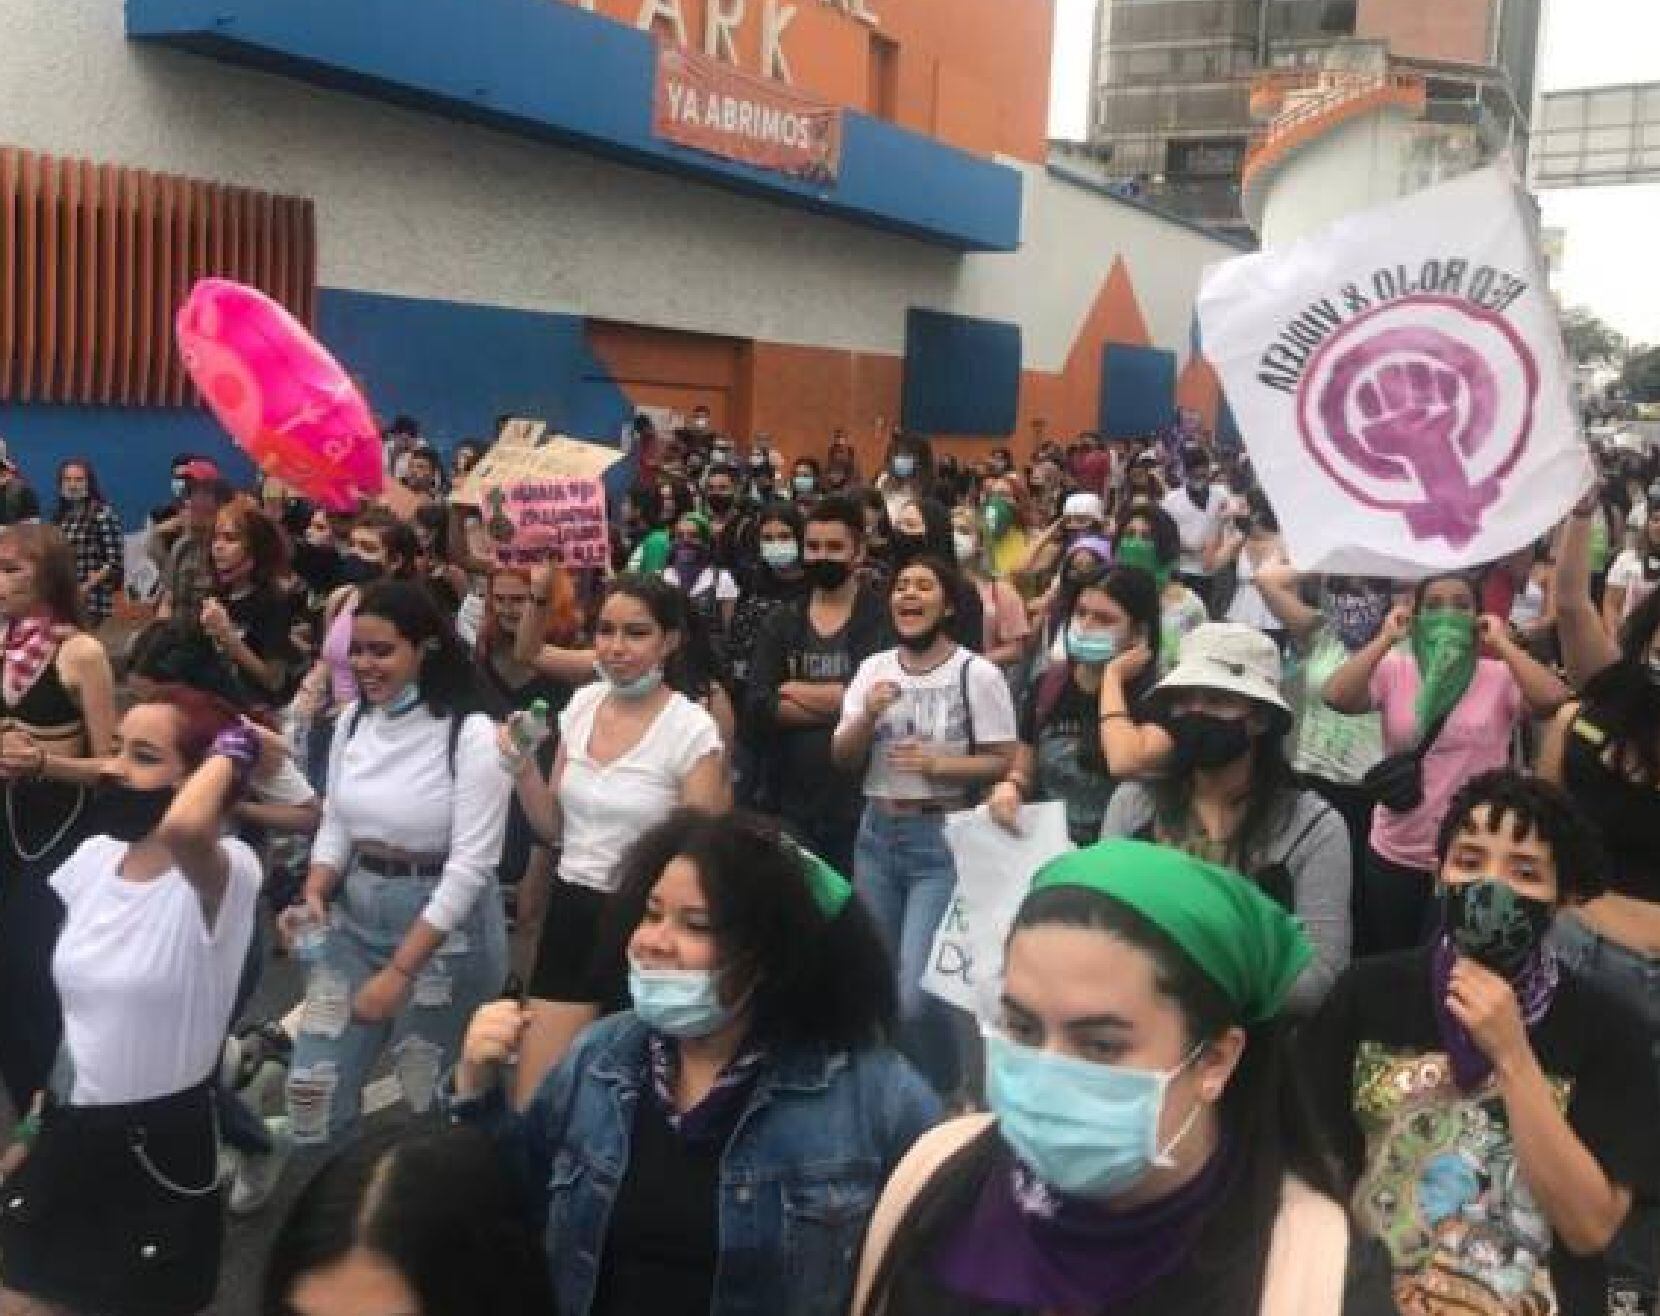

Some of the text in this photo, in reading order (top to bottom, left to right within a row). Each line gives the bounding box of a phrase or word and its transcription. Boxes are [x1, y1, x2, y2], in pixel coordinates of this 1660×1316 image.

[578, 0, 796, 86] ARK
[666, 81, 810, 149] YA ABRIMOS
